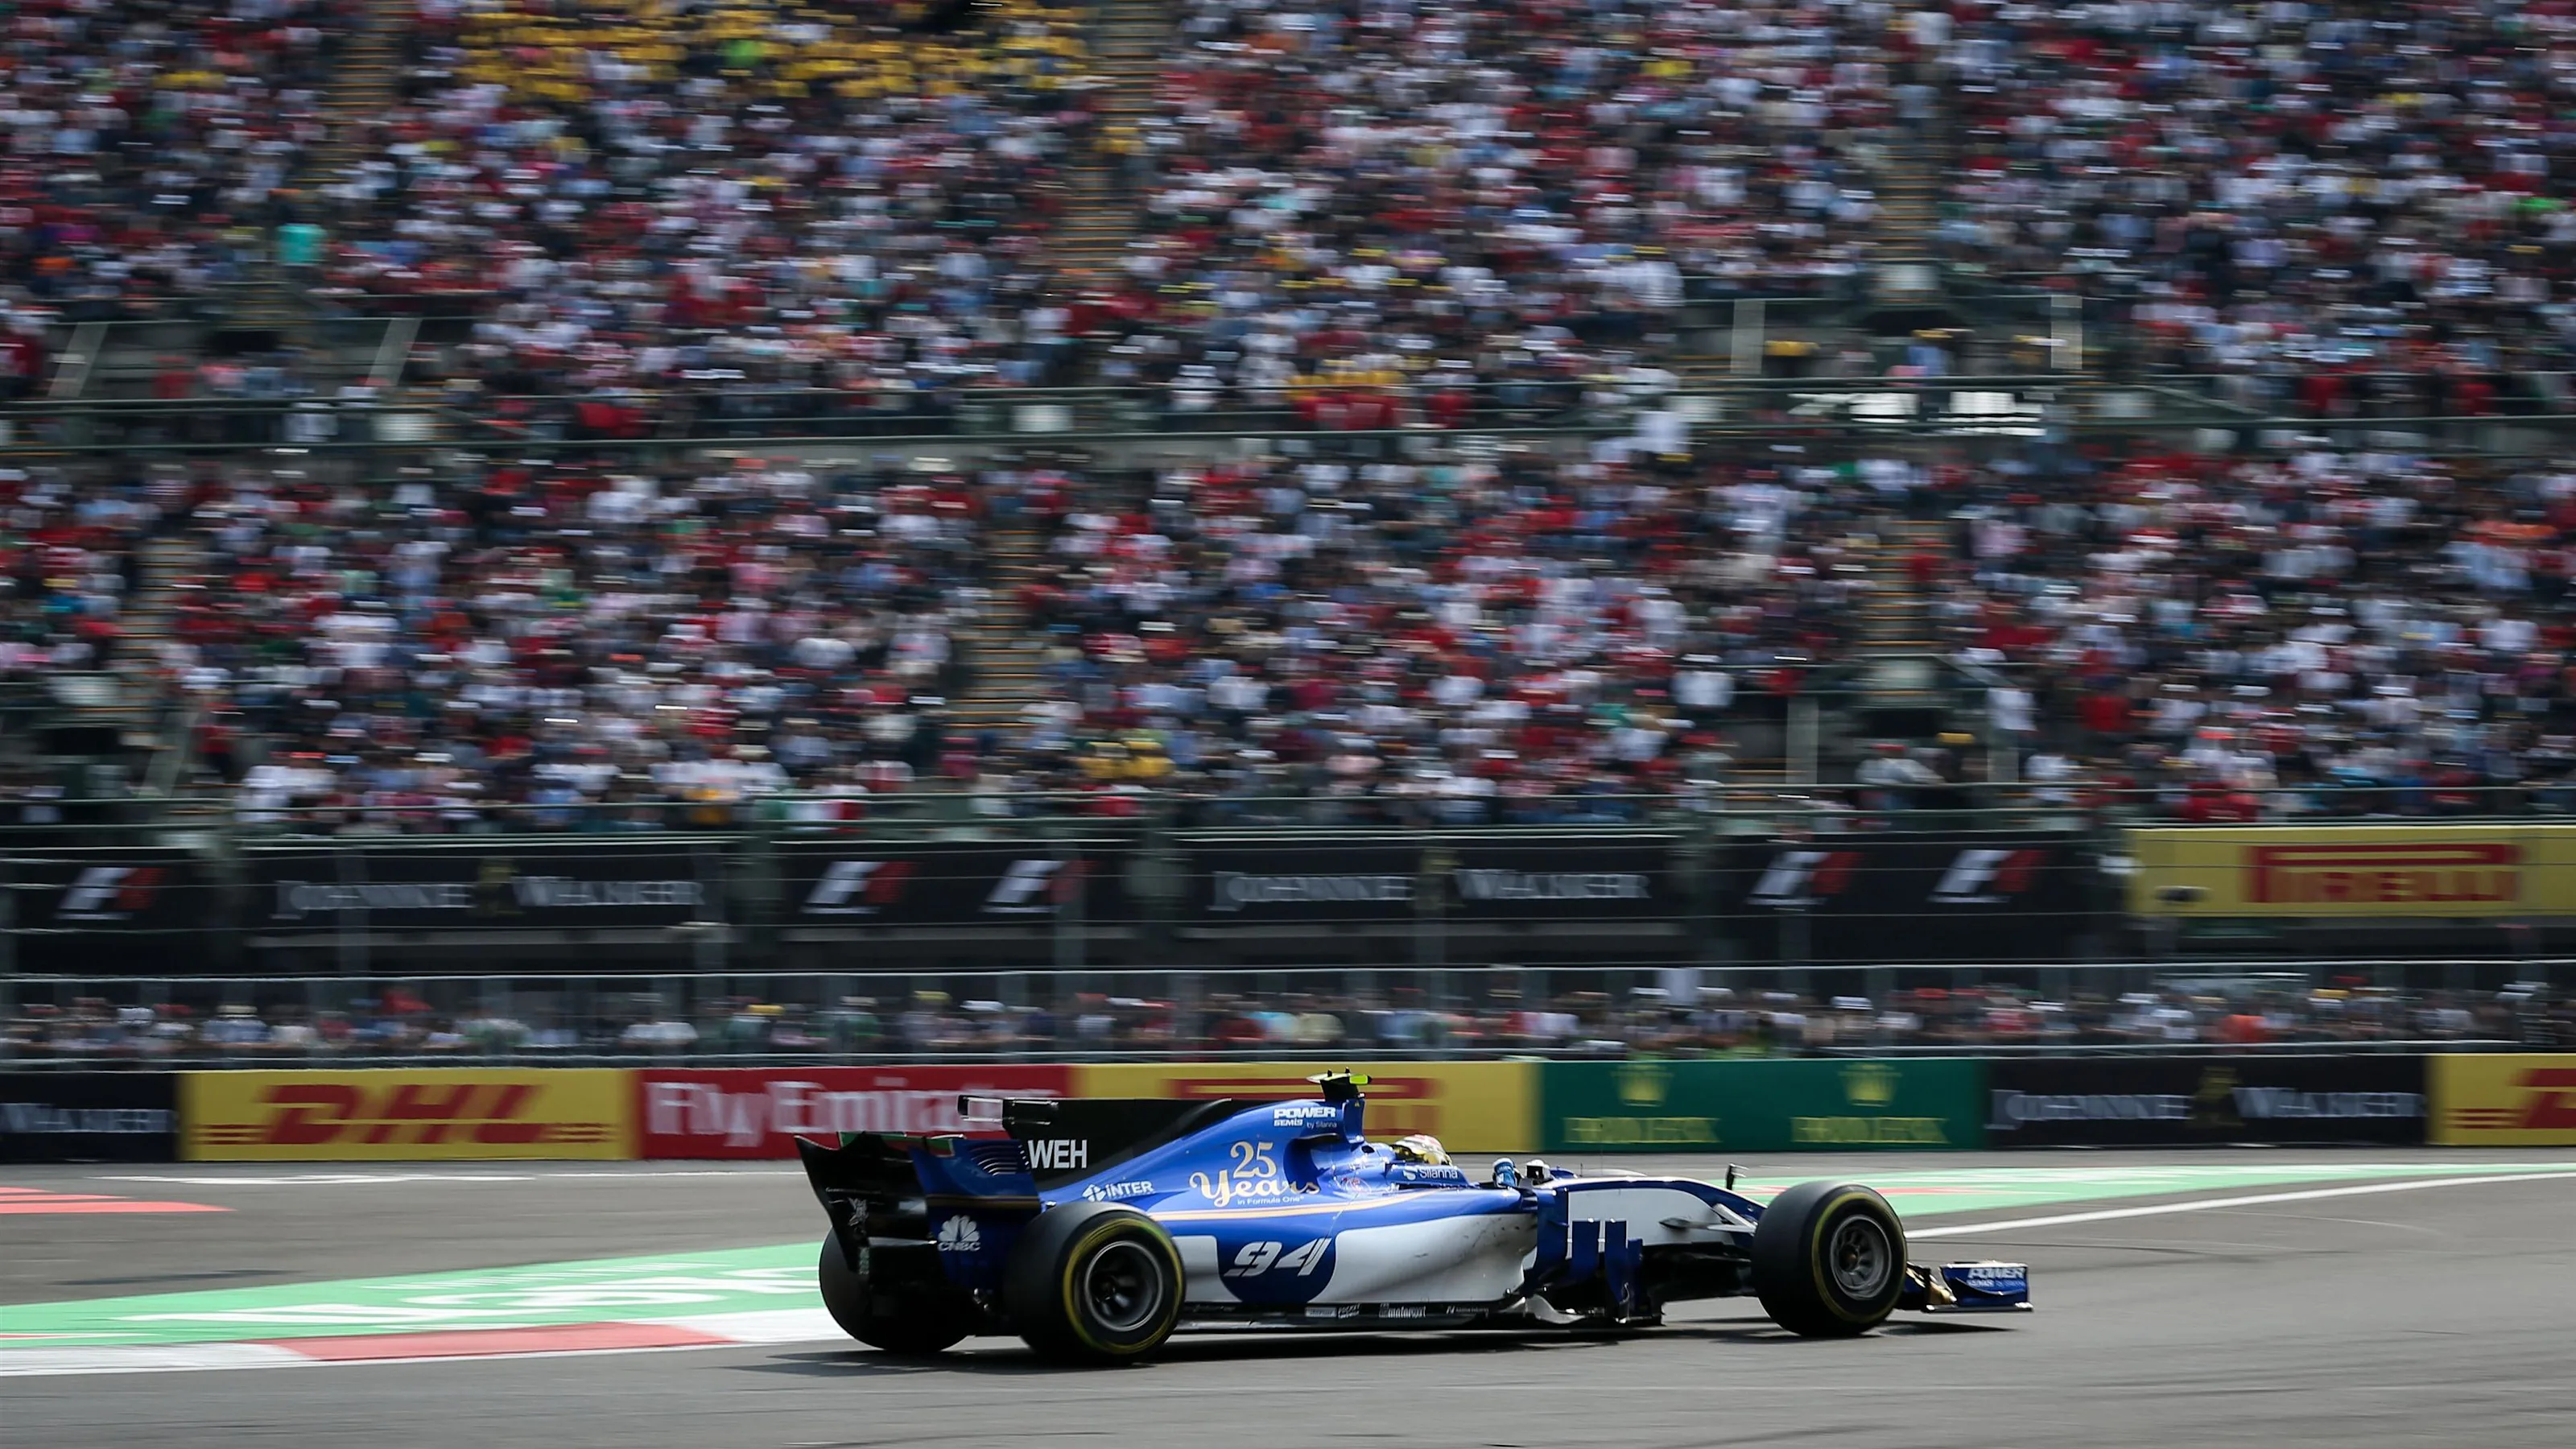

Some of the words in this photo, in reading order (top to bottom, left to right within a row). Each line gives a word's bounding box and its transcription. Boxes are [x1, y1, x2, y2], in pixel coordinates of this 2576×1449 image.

[252, 1084, 549, 1144] DHL
[645, 1081, 769, 1146] Fly
[1274, 1106, 1336, 1119] POWER
[1027, 1139, 1088, 1169] WEH
[1230, 1141, 1278, 1179] 25
[1419, 1168, 1459, 1179] Silanna
[1189, 1170, 1321, 1208] Years
[1247, 1197, 1281, 1205] Formula
[937, 1241, 981, 1252] CNBC
[1223, 1237, 1332, 1278] 94
[1967, 1267, 2026, 1278] POWER
